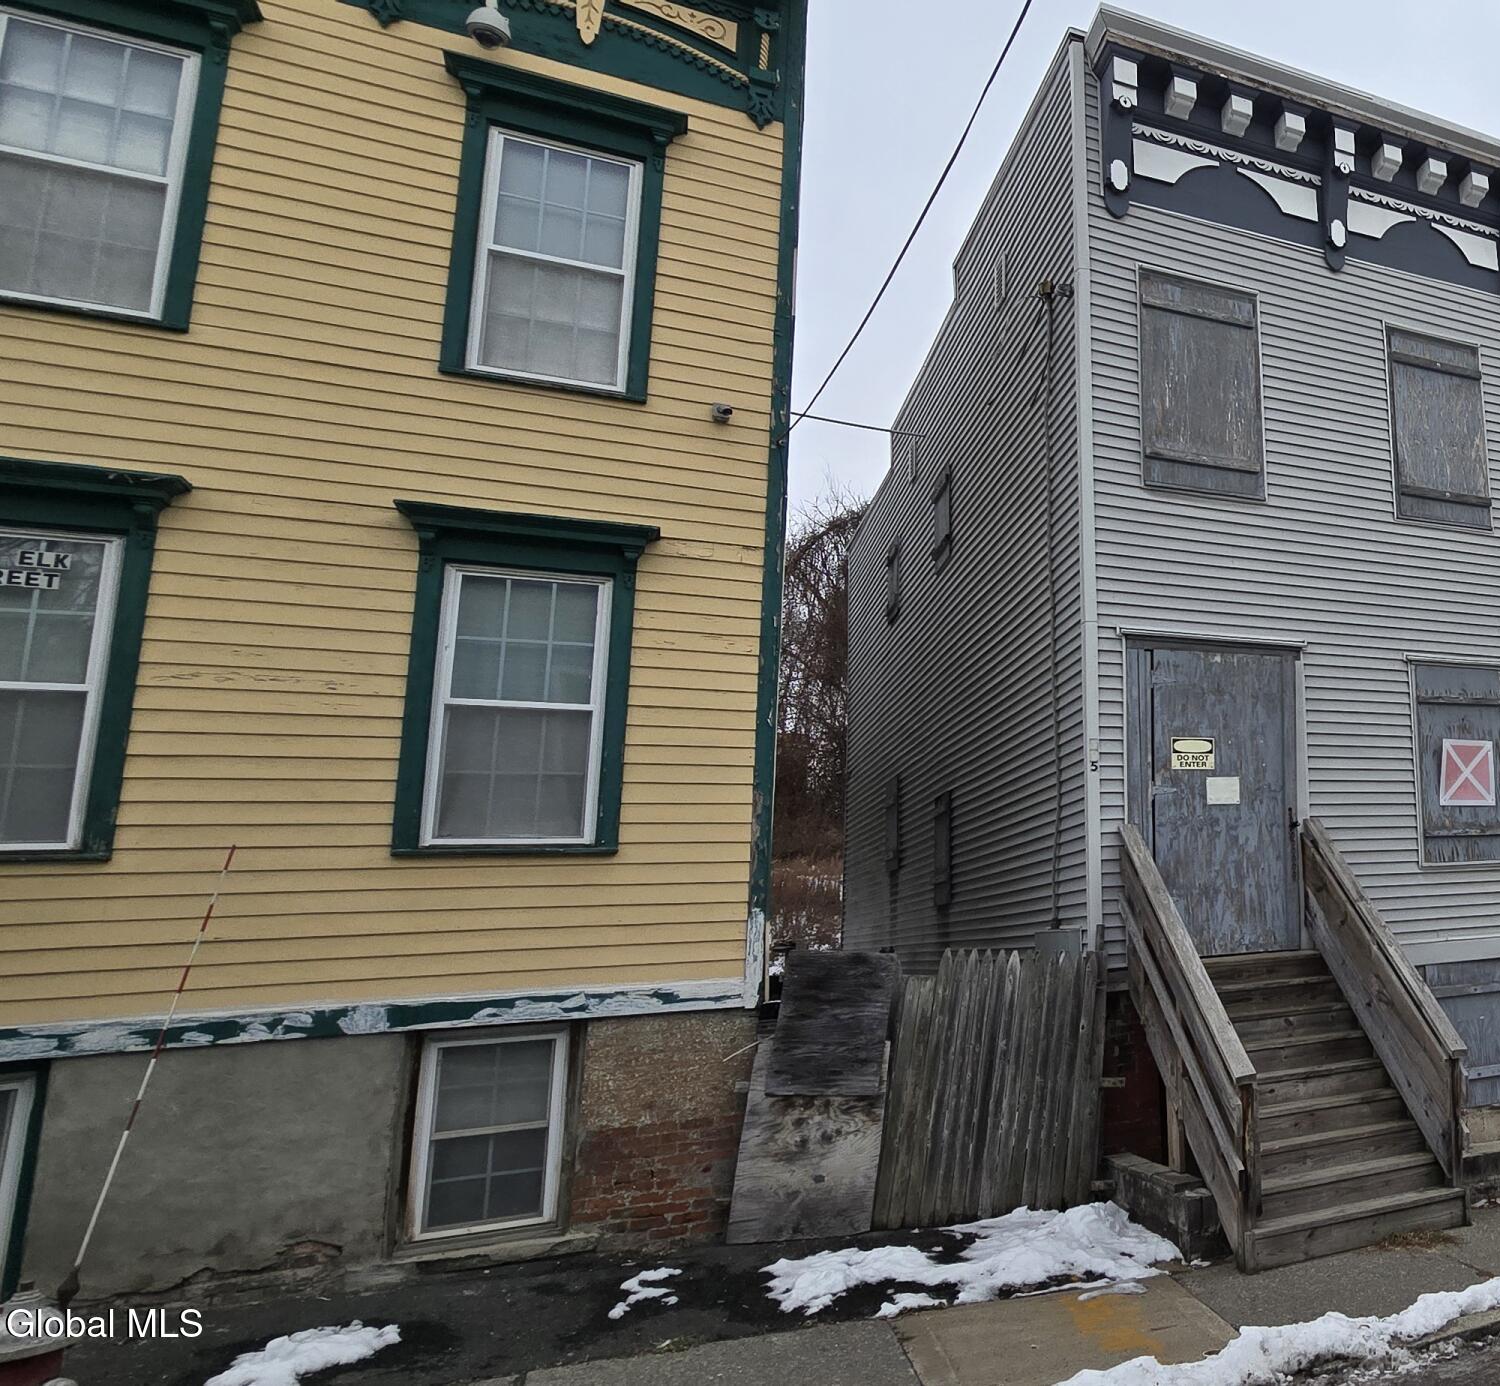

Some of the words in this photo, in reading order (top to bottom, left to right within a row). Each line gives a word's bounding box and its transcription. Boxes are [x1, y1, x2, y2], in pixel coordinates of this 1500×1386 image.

[18, 551, 70, 568] ELK
[0, 570, 60, 588] EET
[1090, 761, 1098, 771] 5
